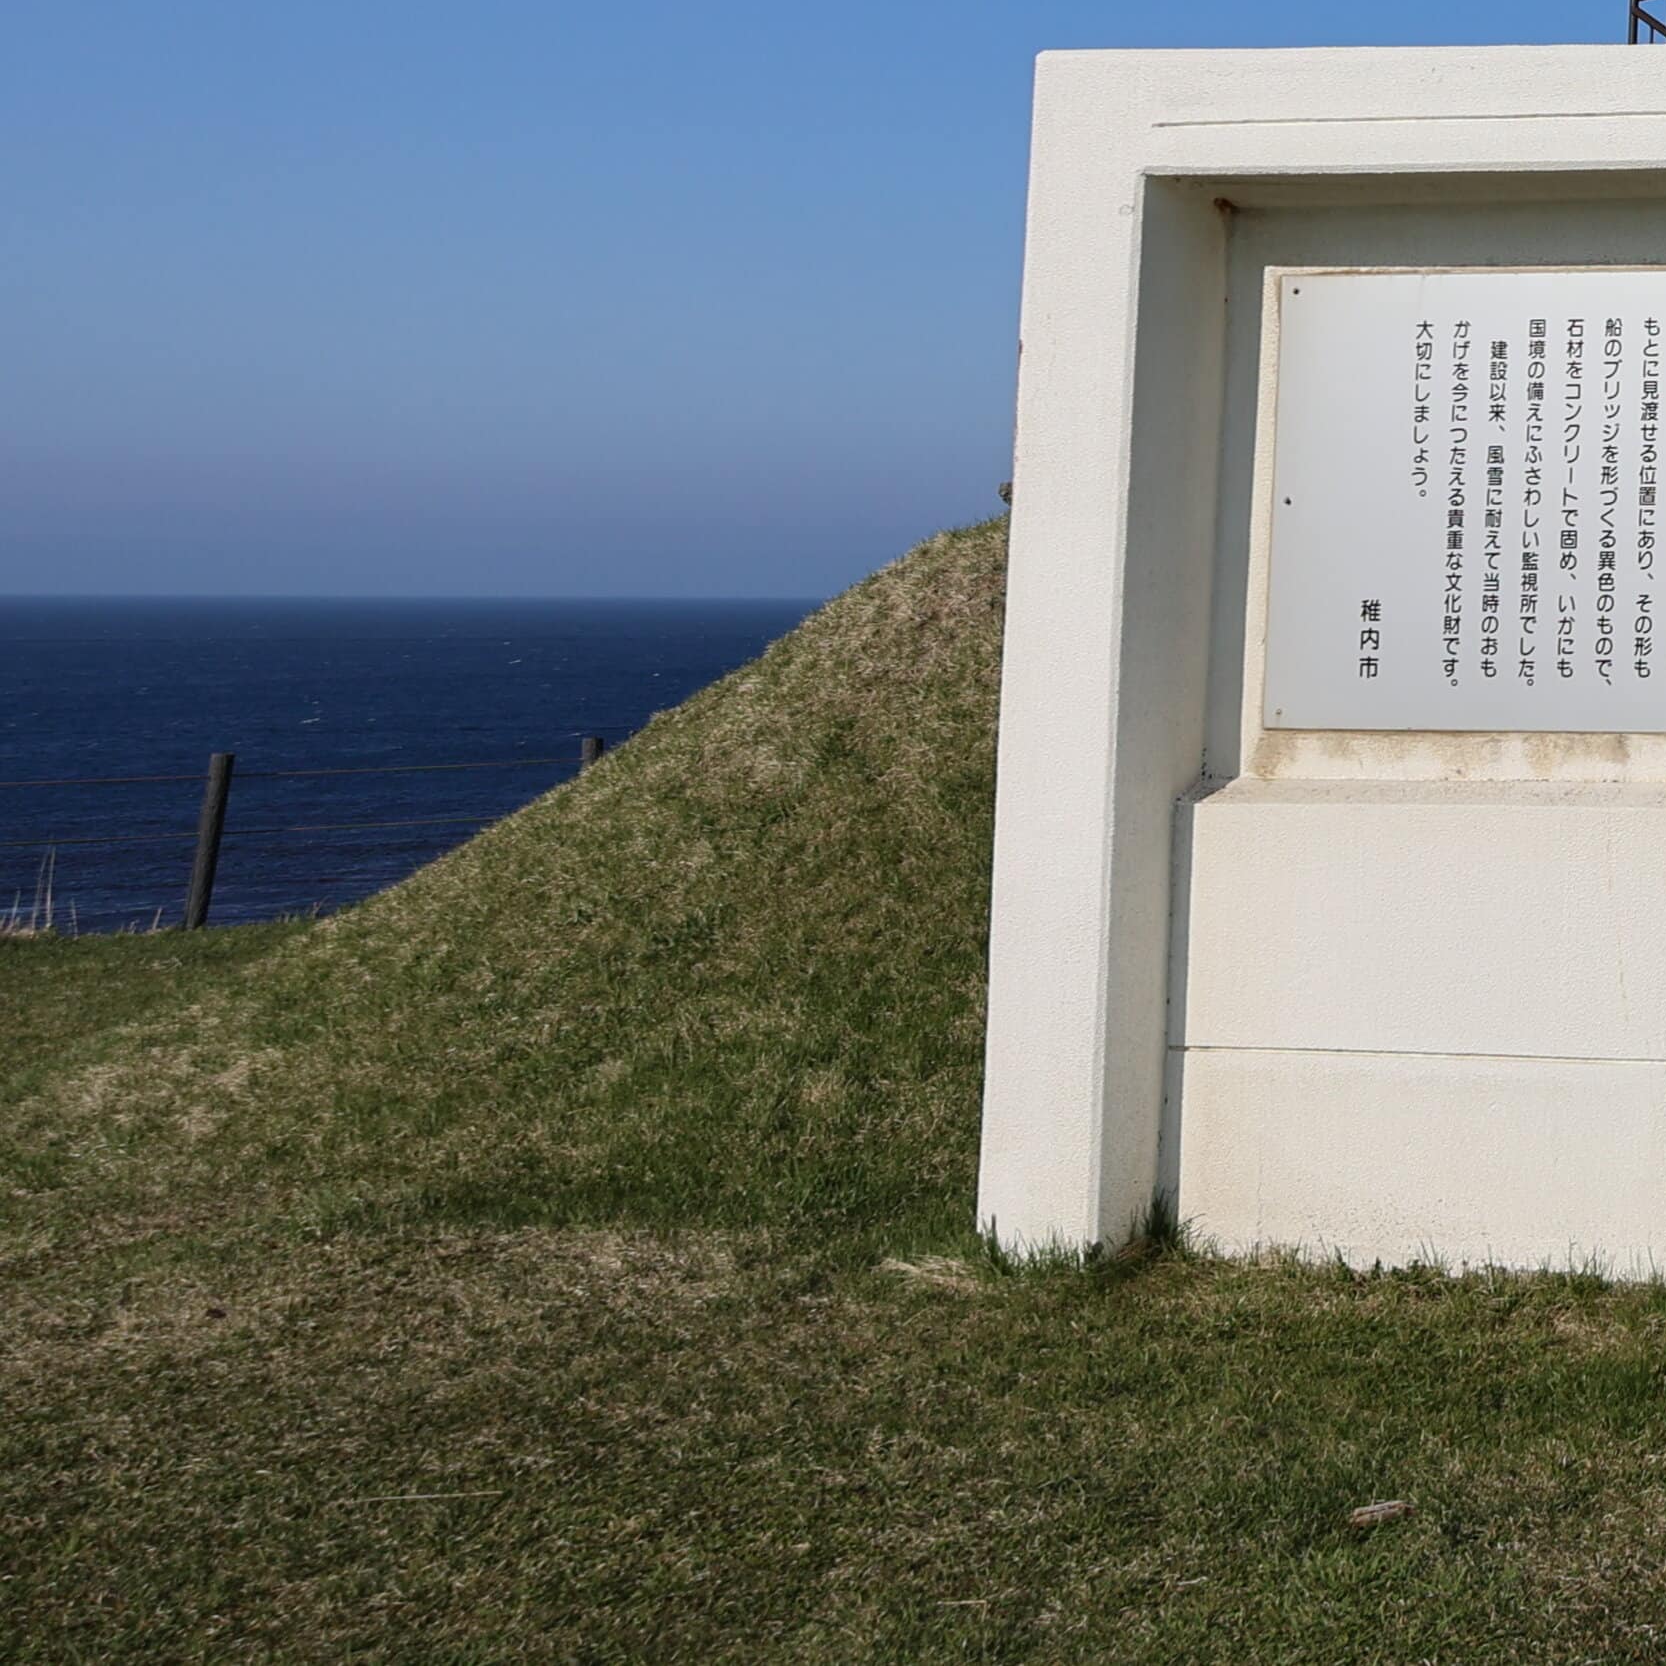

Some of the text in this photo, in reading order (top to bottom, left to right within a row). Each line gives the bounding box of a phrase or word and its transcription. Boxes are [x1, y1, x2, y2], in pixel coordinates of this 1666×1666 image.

[1411, 320, 1435, 498] 大切にしましょう。
[1442, 320, 1472, 687] かげを今につたえる貴重な文化財です。
[1480, 340, 1509, 678] 建設以来、風雪に耐えて当時のおも
[1518, 318, 1547, 687] 国境の備えにふさわしい監視所でした。
[1556, 318, 1585, 679] 石材をコンクリートで固め、いかにも
[1594, 317, 1623, 686] 船のブリッジを形づくる異色のもので、
[1633, 317, 1661, 679] もとに見渡せる位置にあり、その形も
[1359, 599, 1382, 679] 稚内市
